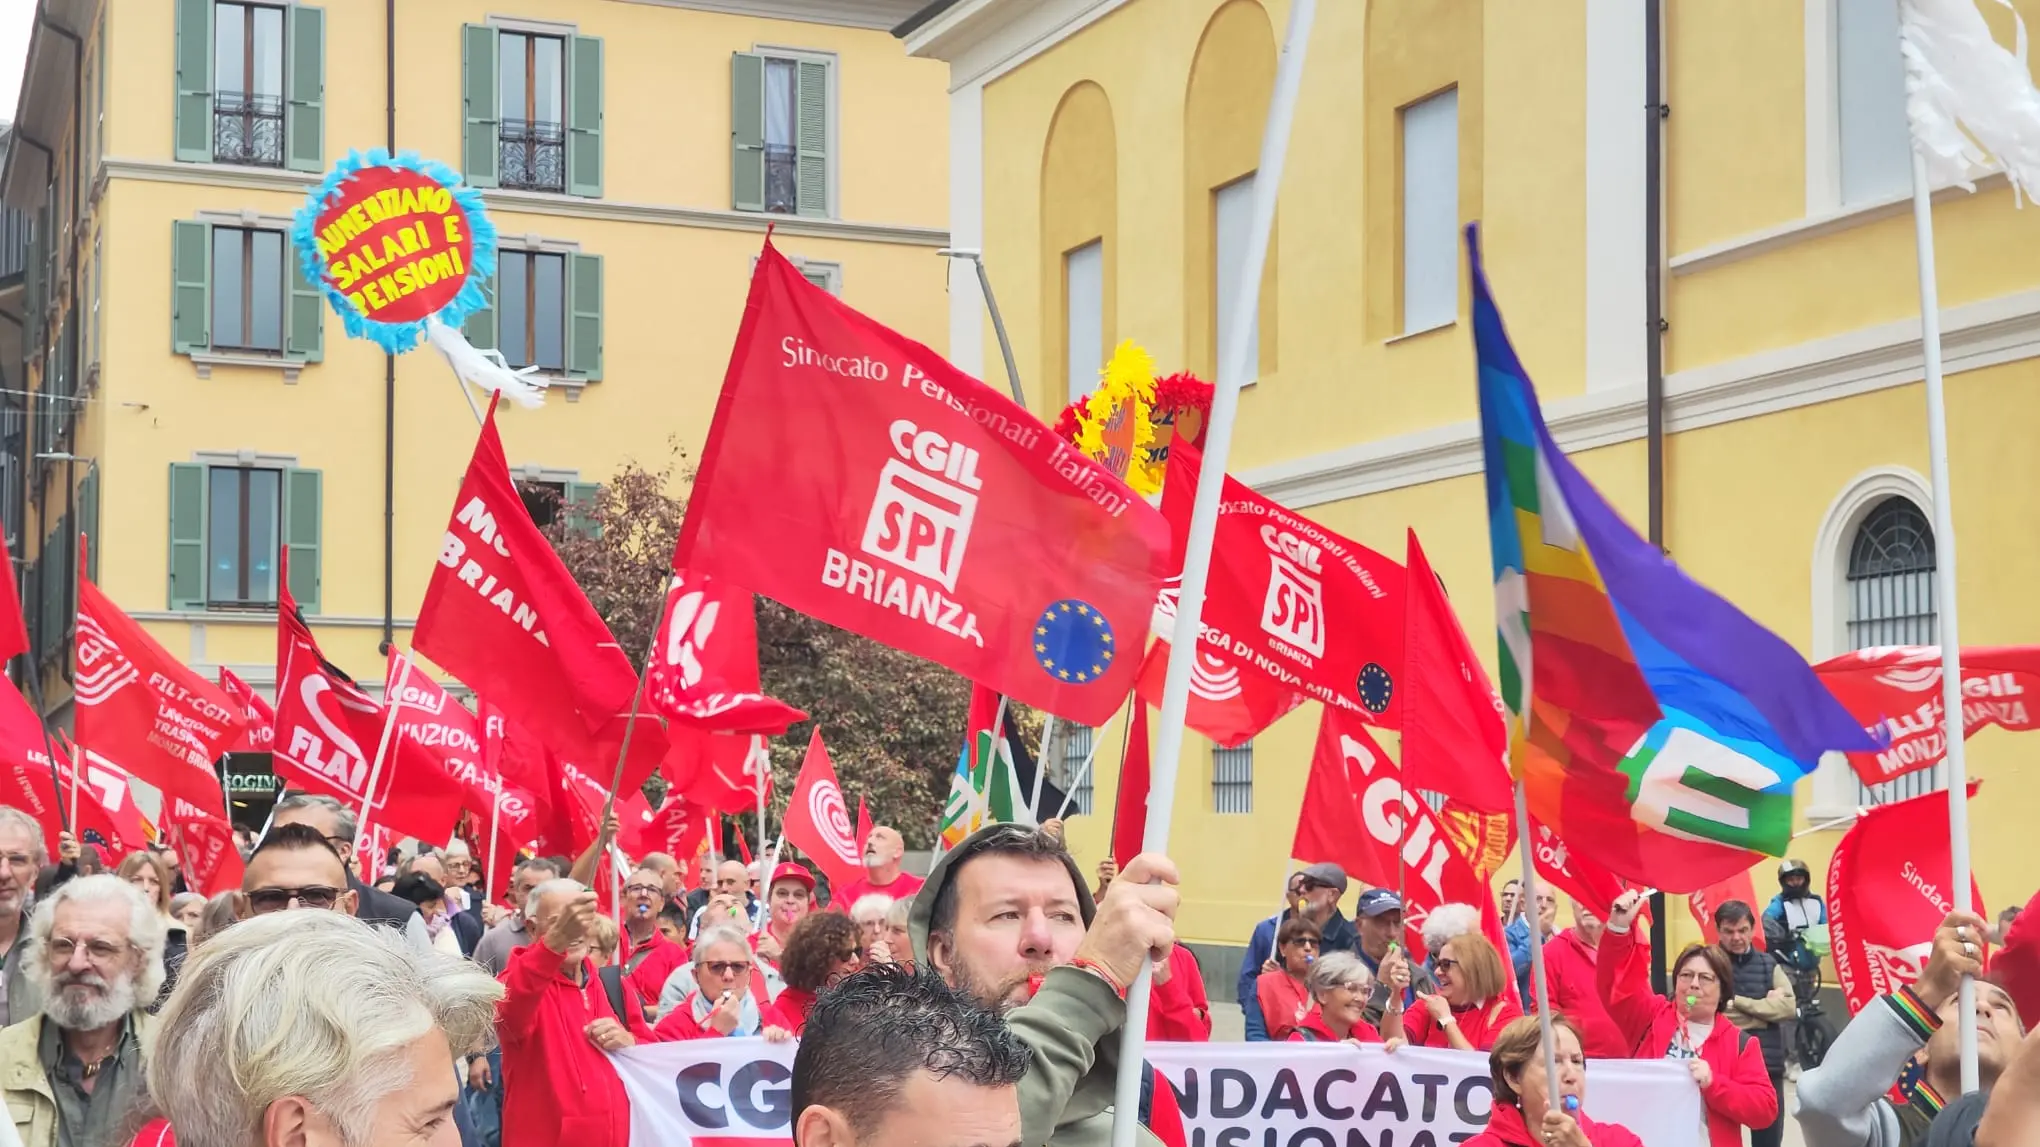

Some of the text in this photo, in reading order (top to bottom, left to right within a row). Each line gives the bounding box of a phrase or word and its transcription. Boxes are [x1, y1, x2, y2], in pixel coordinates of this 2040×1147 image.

[330, 215, 463, 290] SALARI E
[348, 247, 464, 317] PENSIONI
[889, 419, 983, 491] CGIL
[902, 363, 1042, 451] Pensionati
[1048, 441, 1131, 518] Italiani
[876, 501, 957, 577] SPI
[1260, 524, 1323, 575] CGIL
[1267, 508, 1342, 558] Pensionati
[1342, 554, 1387, 600] Italiani
[822, 547, 984, 649] BRIANZA
[1271, 583, 1320, 647] SPI
[1233, 641, 1253, 661] DI
[1254, 653, 1302, 687] NOVA
[148, 671, 232, 727] FILT-CGIL
[287, 725, 369, 794] FLAI
[1829, 849, 1845, 899] LEGA
[1900, 860, 1958, 918] Sindac
[1830, 899, 1842, 922] DI
[1832, 922, 1856, 997] MONZA
